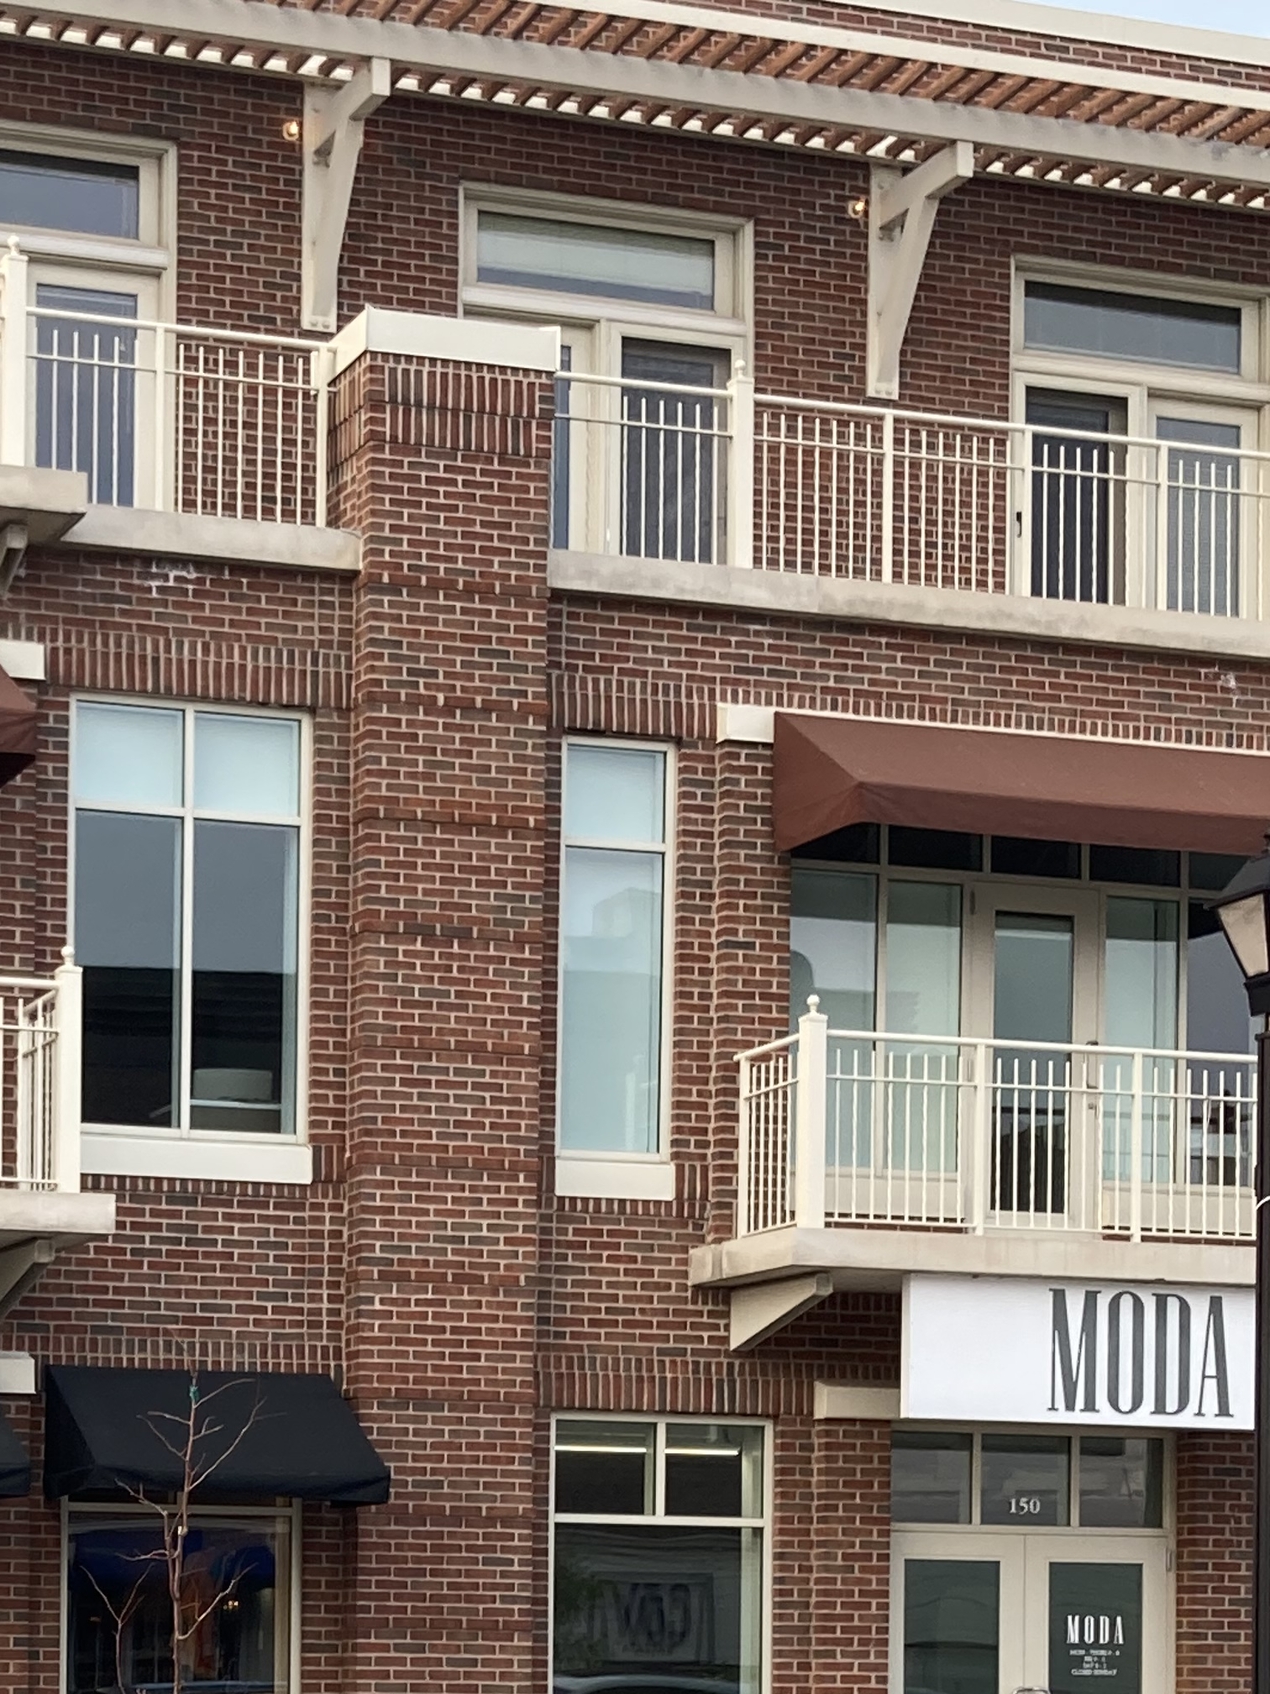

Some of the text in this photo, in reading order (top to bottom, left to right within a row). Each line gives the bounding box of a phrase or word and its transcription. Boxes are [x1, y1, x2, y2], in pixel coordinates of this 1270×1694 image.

[1047, 1288, 1234, 1418] MODA
[1009, 1497, 1041, 1515] 150
[1066, 1614, 1125, 1645] MODA
